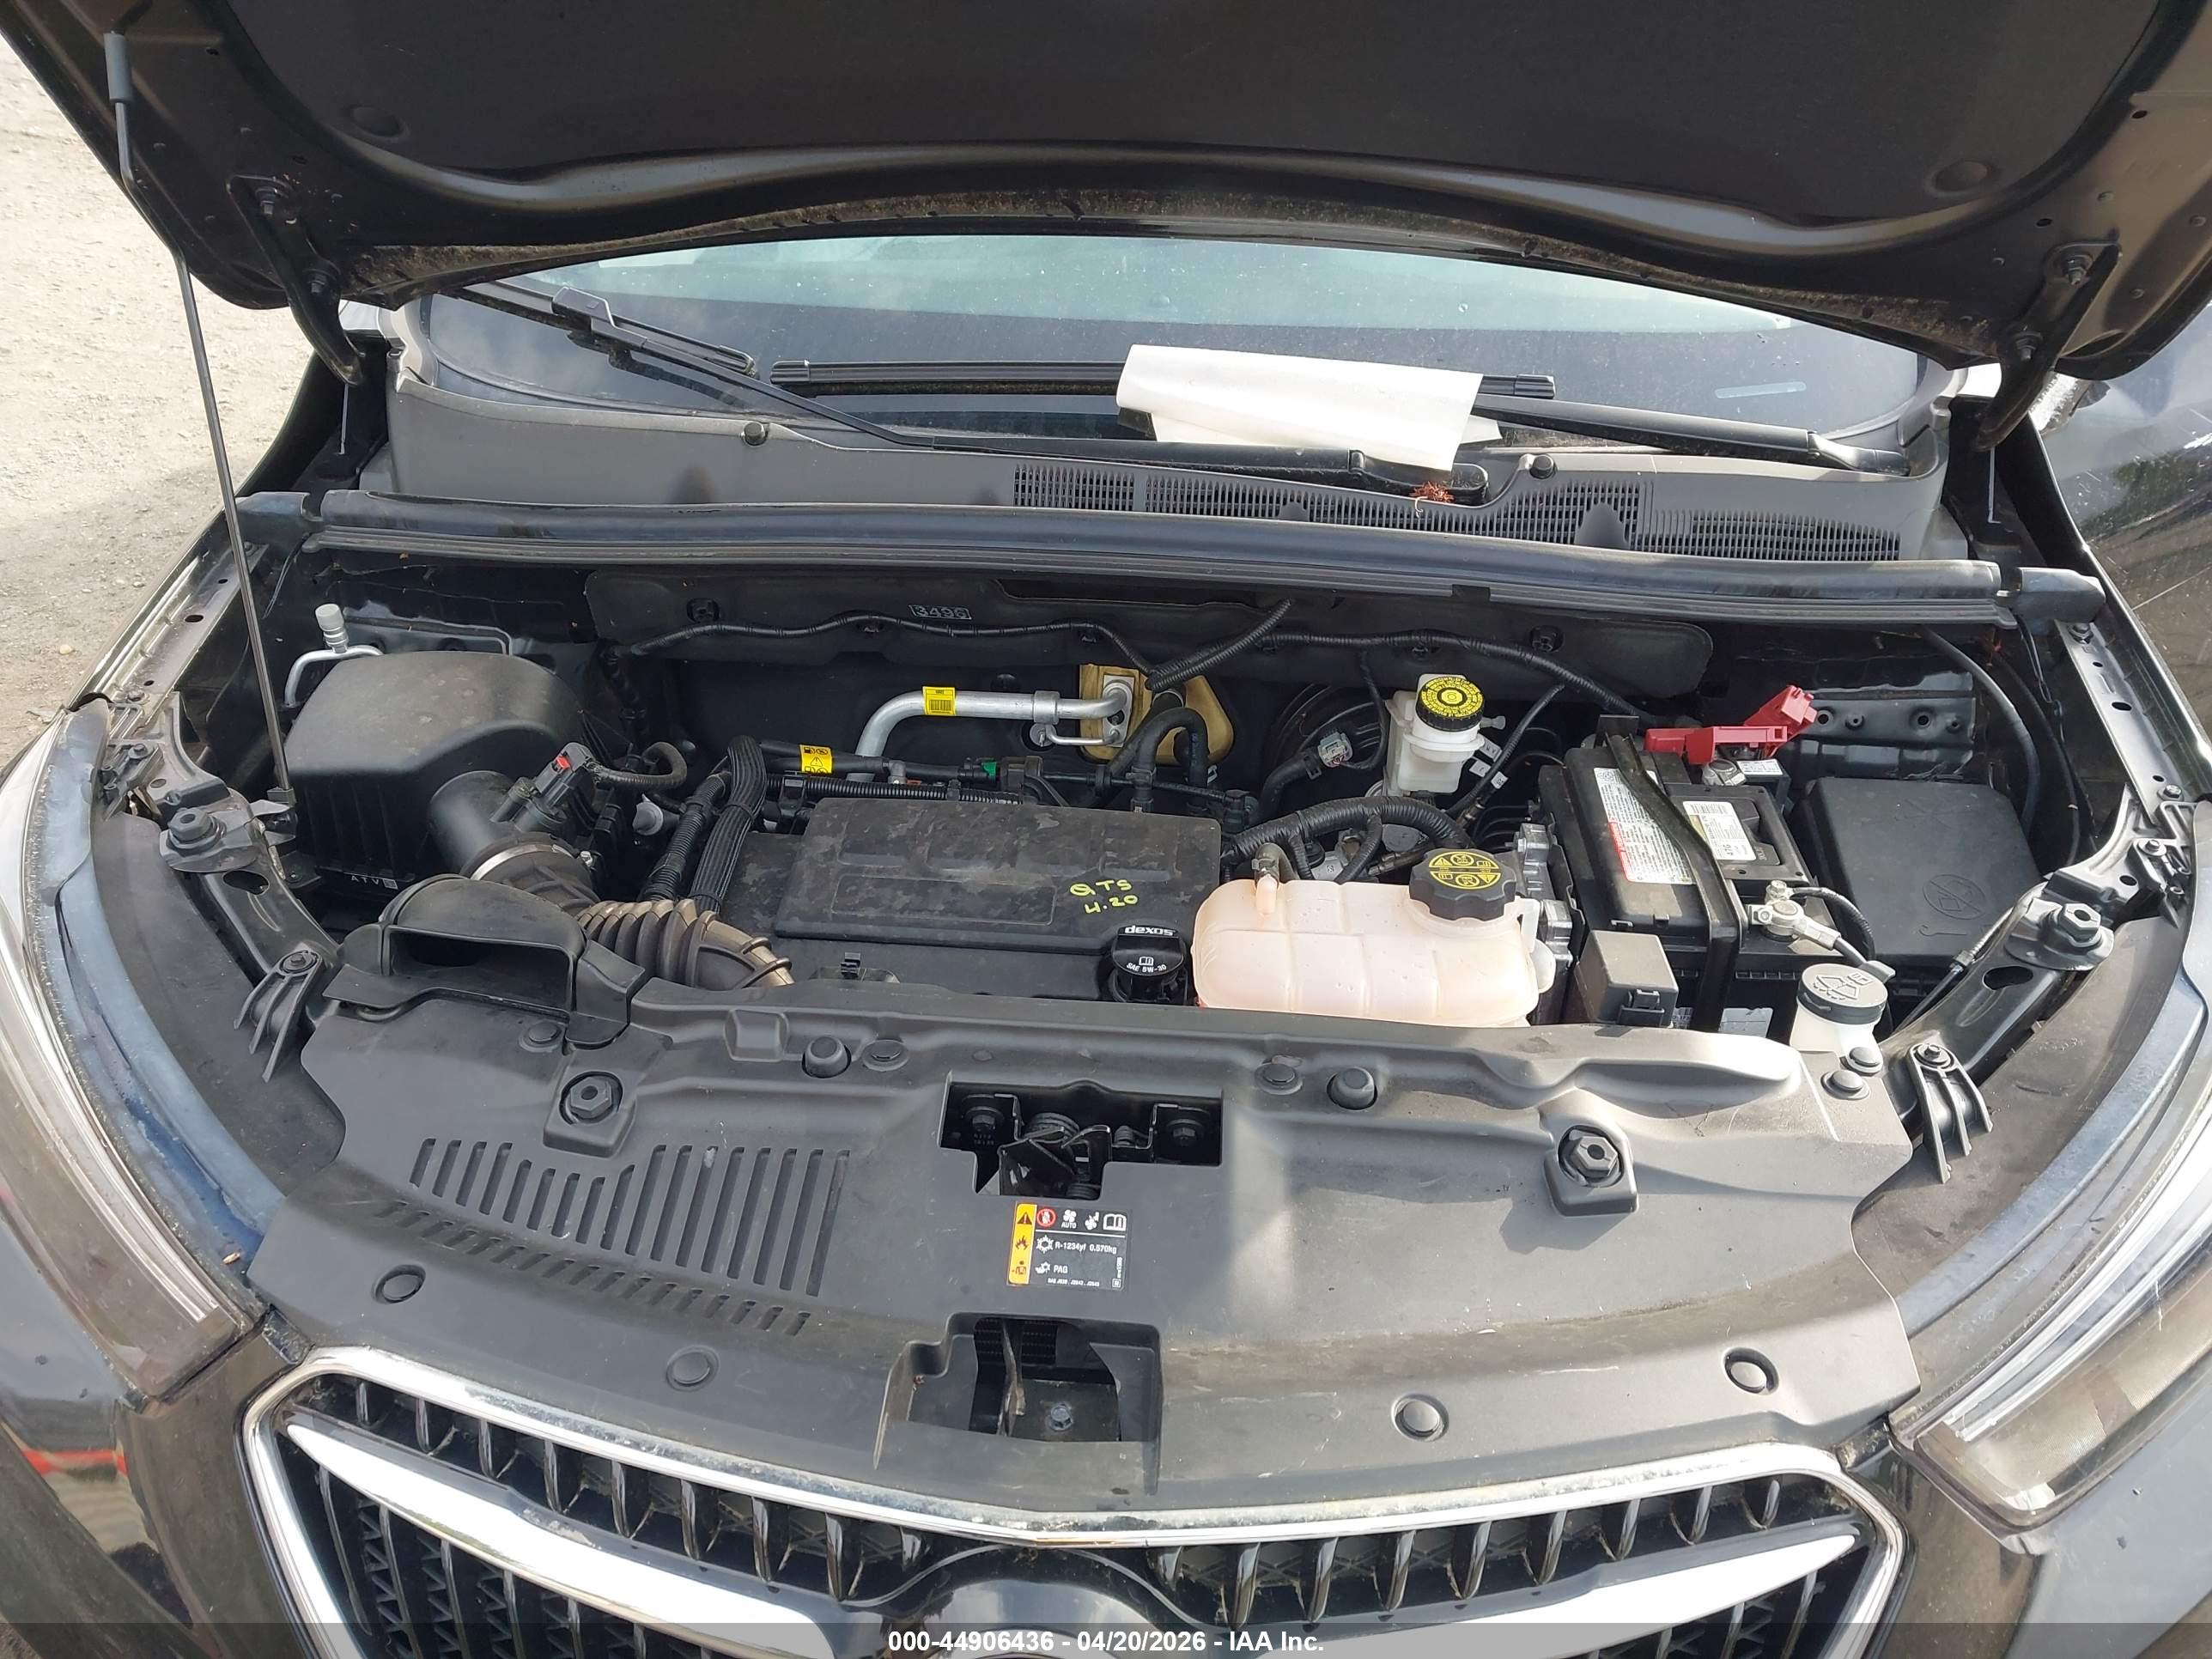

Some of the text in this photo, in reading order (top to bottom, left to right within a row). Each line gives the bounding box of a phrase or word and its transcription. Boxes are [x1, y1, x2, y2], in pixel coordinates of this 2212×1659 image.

[1125, 925, 1174, 936] dexos
[1126, 962, 1140, 972] SAE
[1054, 1241, 1086, 1252] R-1234yf
[1053, 1264, 1068, 1274] PAG
